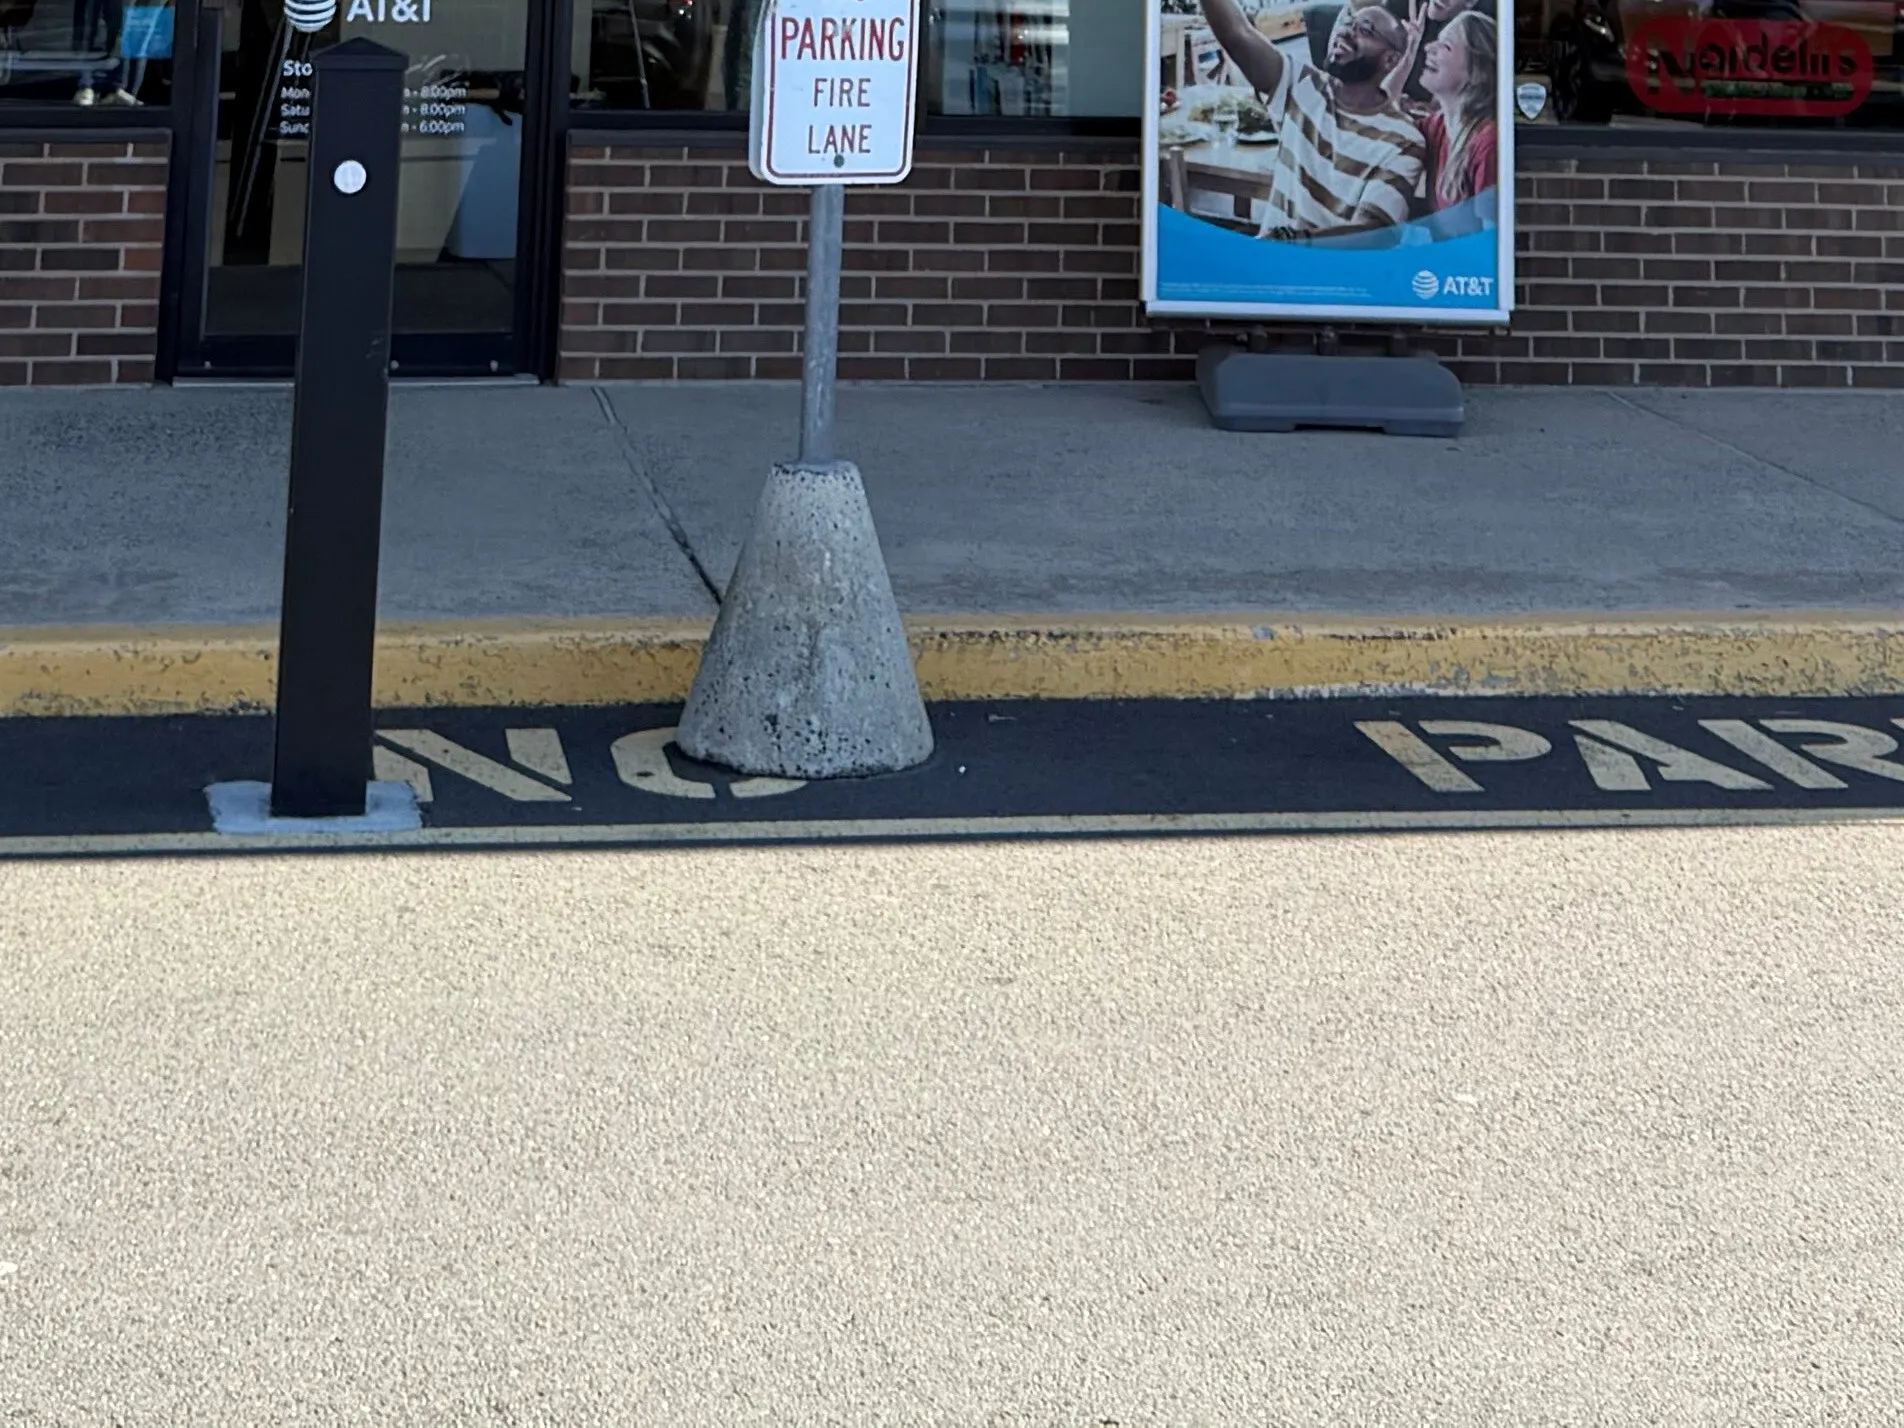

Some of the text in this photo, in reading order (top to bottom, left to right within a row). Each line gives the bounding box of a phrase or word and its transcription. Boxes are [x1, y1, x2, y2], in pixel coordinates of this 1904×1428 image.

[780, 16, 905, 62] PARKING
[282, 59, 314, 77] Sto
[280, 86, 310, 99] Mon
[813, 77, 872, 108] FIRE
[280, 103, 310, 116] Satu
[280, 121, 310, 134] Sun
[807, 123, 873, 155] LANE
[1443, 275, 1495, 297] AT&T
